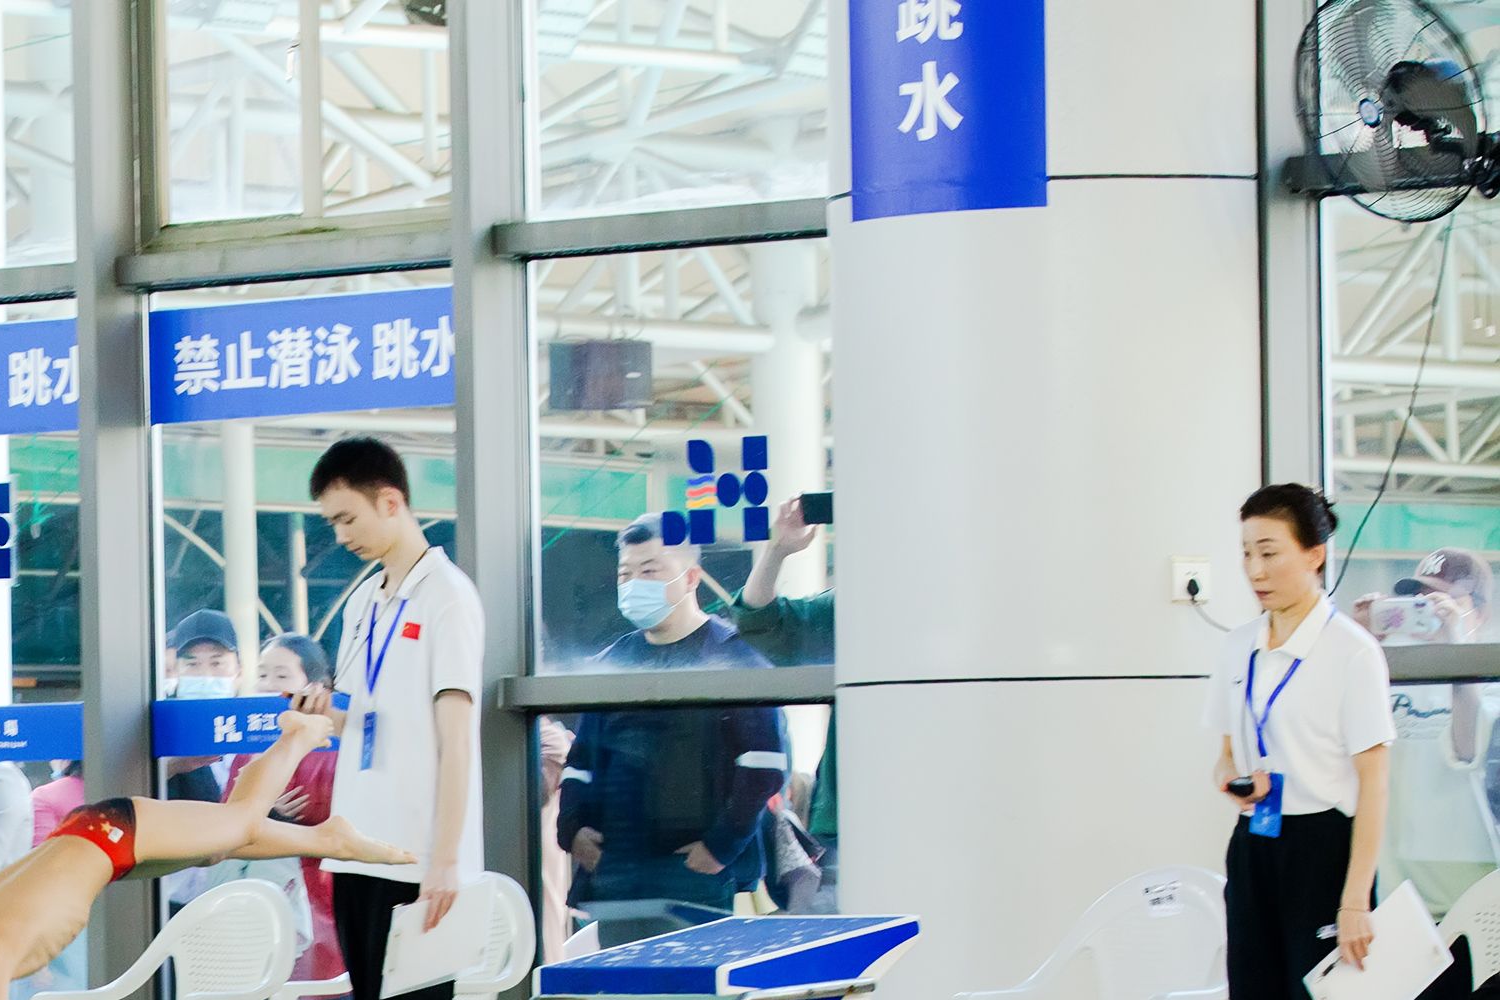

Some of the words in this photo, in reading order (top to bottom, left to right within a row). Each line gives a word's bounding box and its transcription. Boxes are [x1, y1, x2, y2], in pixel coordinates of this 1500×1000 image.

[896, 0, 964, 141] 跳水
[173, 323, 362, 396] 禁止潜泳
[372, 315, 456, 381] 跳水
